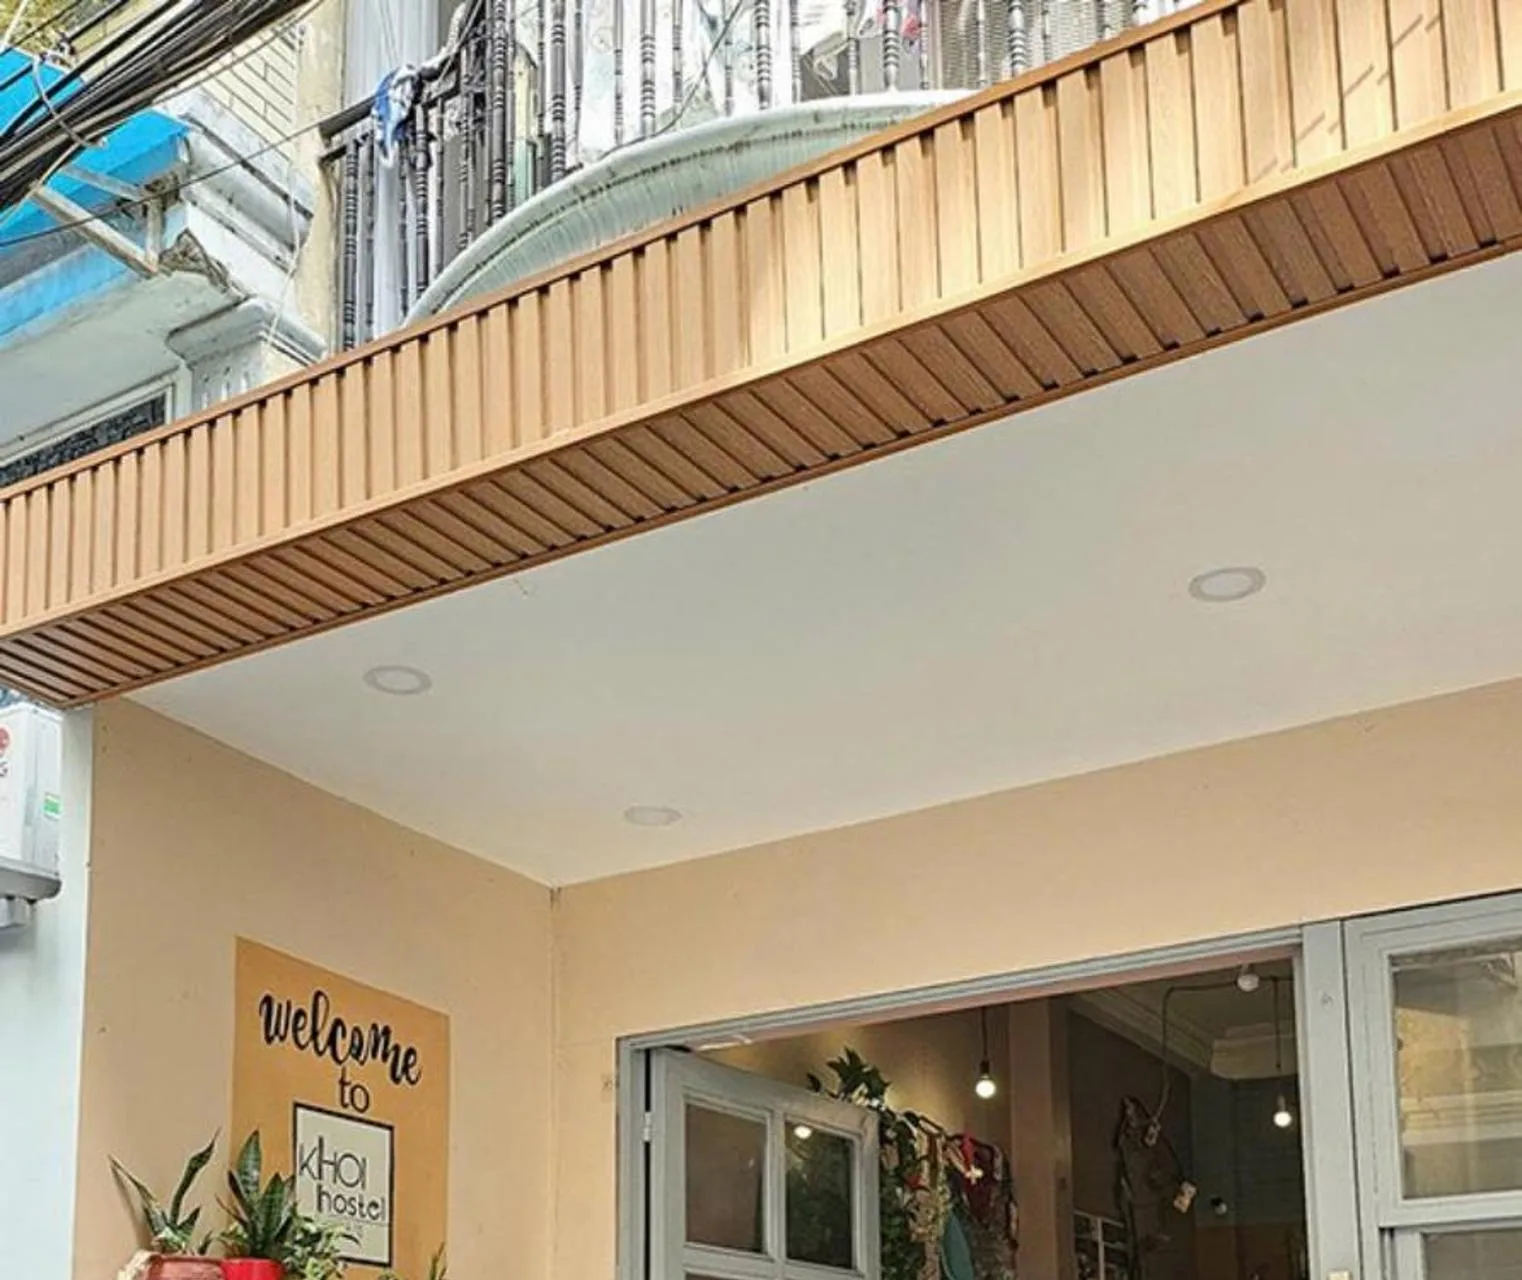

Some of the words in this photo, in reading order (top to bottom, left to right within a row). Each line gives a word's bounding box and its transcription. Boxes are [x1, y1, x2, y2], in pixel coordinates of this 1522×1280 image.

[258, 989, 424, 1086] welcome
[337, 1067, 370, 1113] to
[299, 1136, 368, 1192] KHOI
[316, 1183, 386, 1221] hostel
